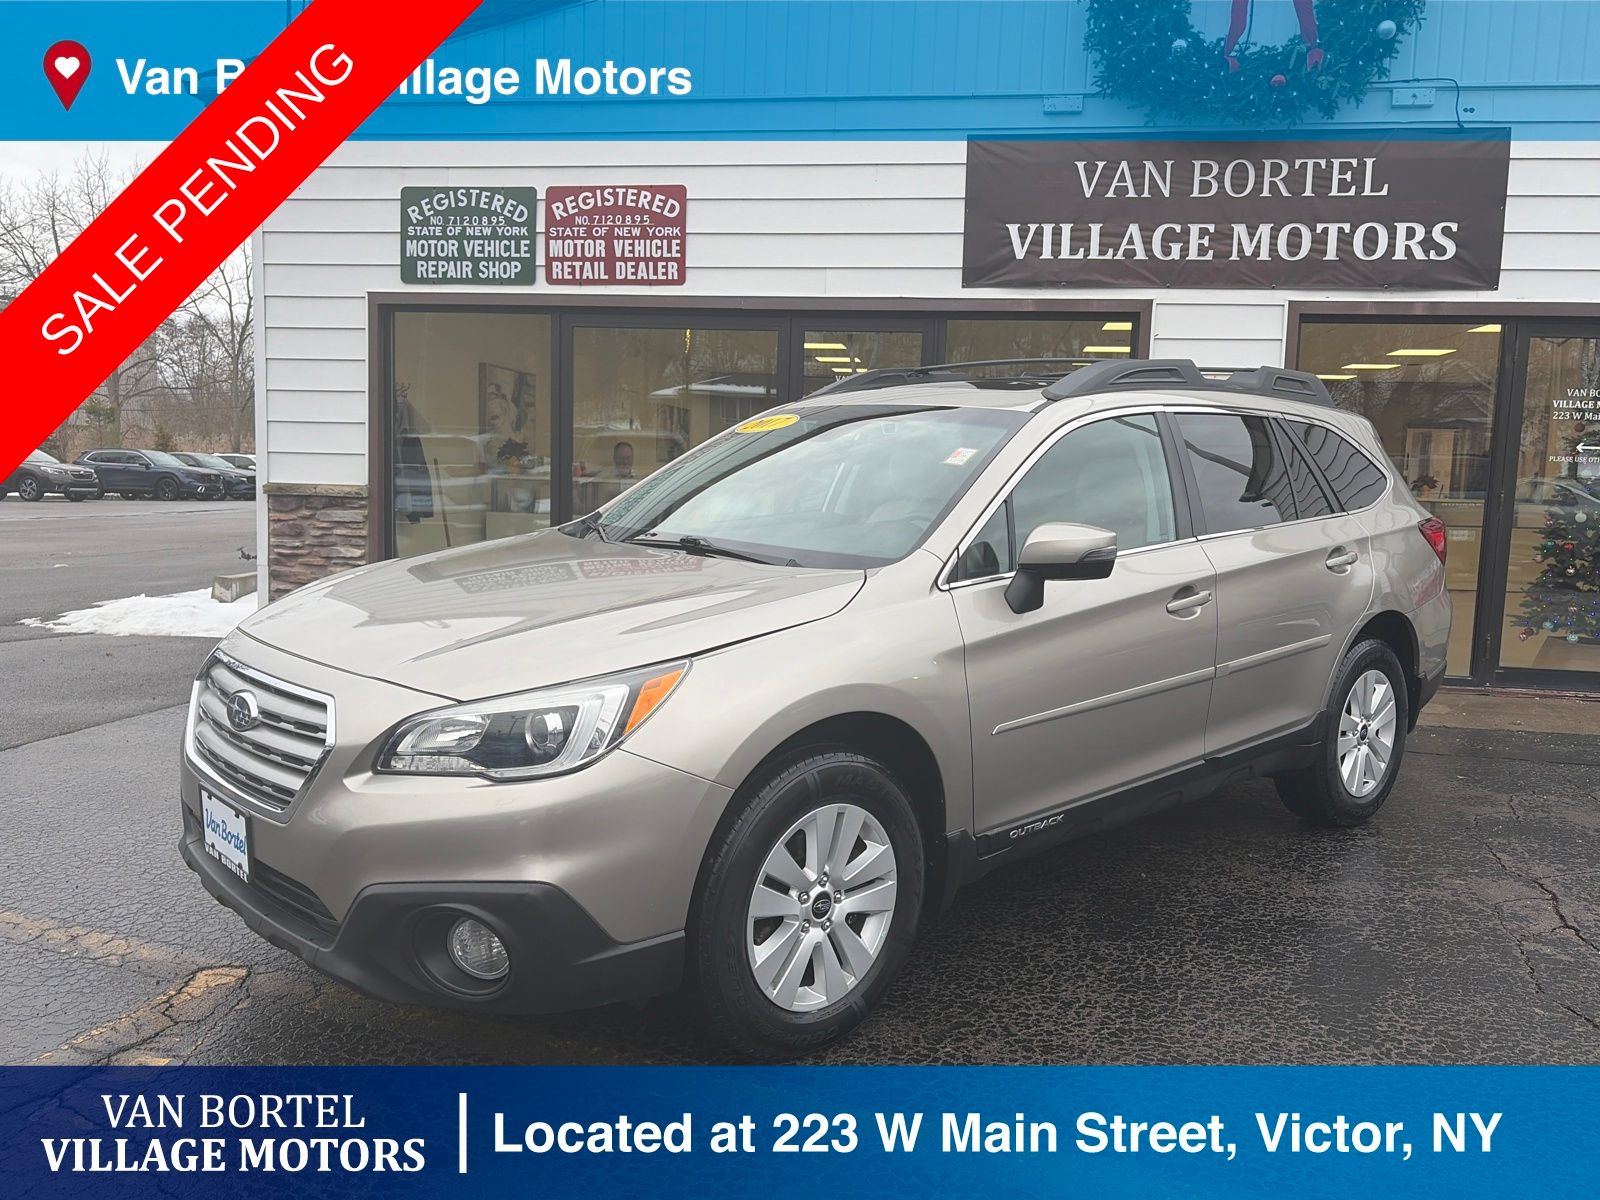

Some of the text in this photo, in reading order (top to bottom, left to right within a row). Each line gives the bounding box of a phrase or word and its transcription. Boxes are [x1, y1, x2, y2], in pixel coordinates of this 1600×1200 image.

[1073, 157, 1389, 198] VAN BORTEL
[407, 188, 529, 224] REGISTERED
[551, 187, 681, 221] REGISTERED
[430, 215, 506, 226] NO. 7120895
[575, 215, 650, 226] NO. 7120895
[407, 226, 529, 236] STATE OF NEW YORK
[549, 227, 681, 237] STATE OF NEW YORK
[406, 239, 531, 258] MOTOR VEHICLE
[549, 239, 681, 258] MOTOR VEHICLE
[1005, 222, 1459, 261] VILLAGE MOTORS
[416, 260, 522, 279] REPAIR SHOP
[552, 261, 678, 280] RETAIL DEALER
[1566, 388, 1587, 397] VAN
[1552, 400, 1595, 409] VILLAGE
[1552, 411, 1570, 420] 223
[1572, 411, 1583, 420] W
[1549, 455, 1574, 463] PLEASE
[1009, 813, 1065, 839] OUTBACK
